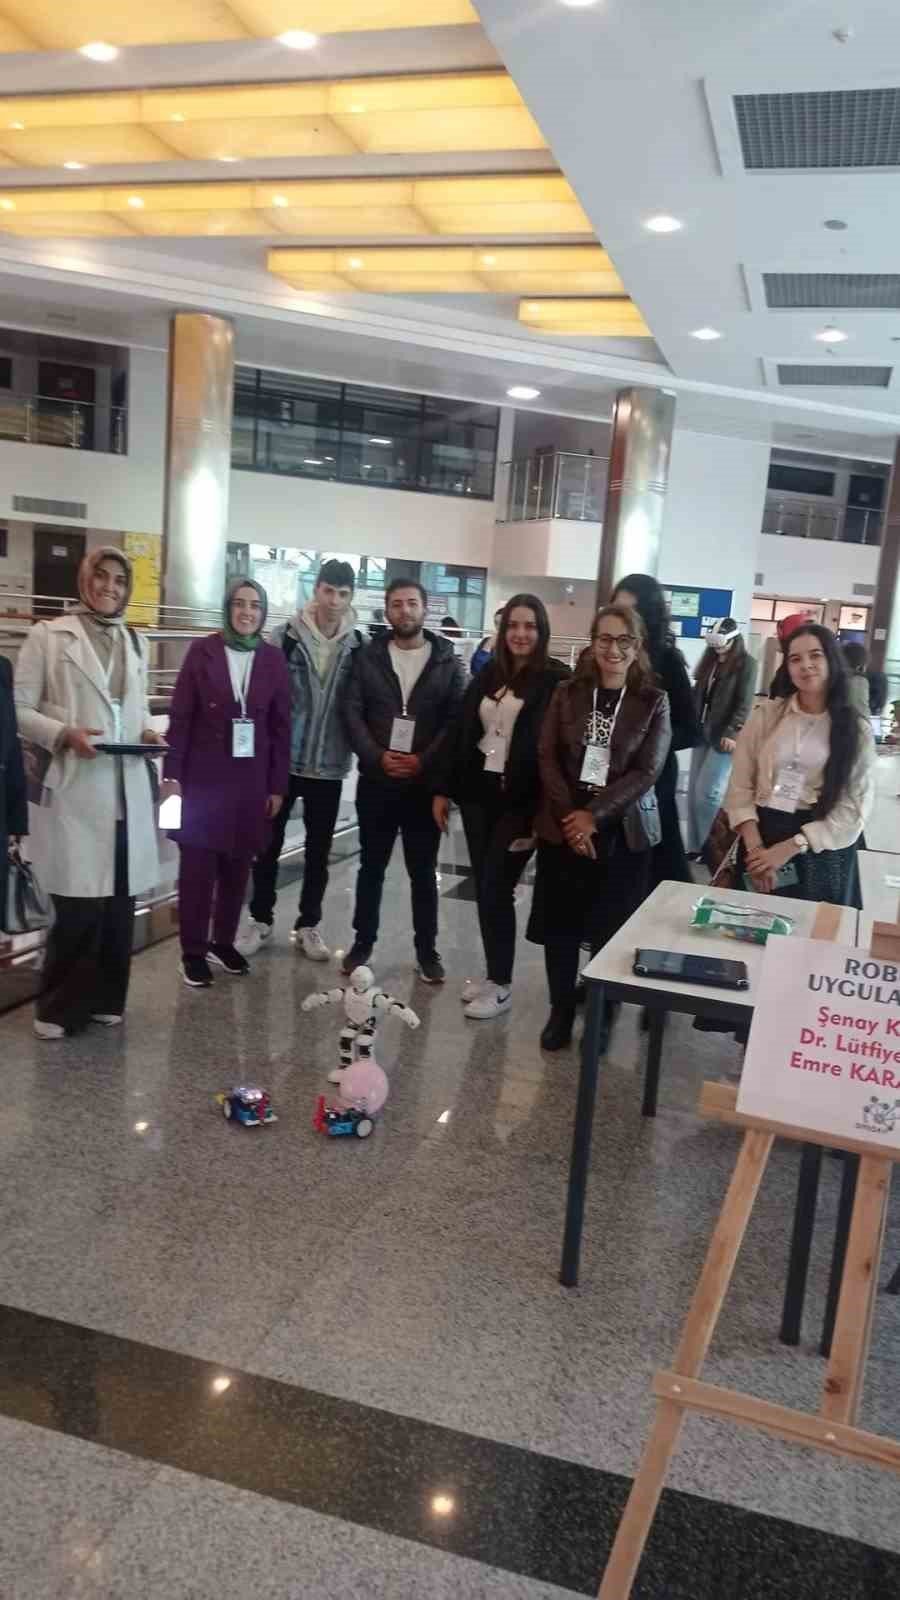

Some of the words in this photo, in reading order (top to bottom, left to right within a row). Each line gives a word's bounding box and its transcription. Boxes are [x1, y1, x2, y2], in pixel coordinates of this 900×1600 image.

[845, 958, 900, 982] ROB
[817, 1006, 879, 1036] Şenay
[800, 1028, 827, 1048] Dr.
[836, 1034, 900, 1064] Lütfiye
[790, 1051, 842, 1077] Emre
